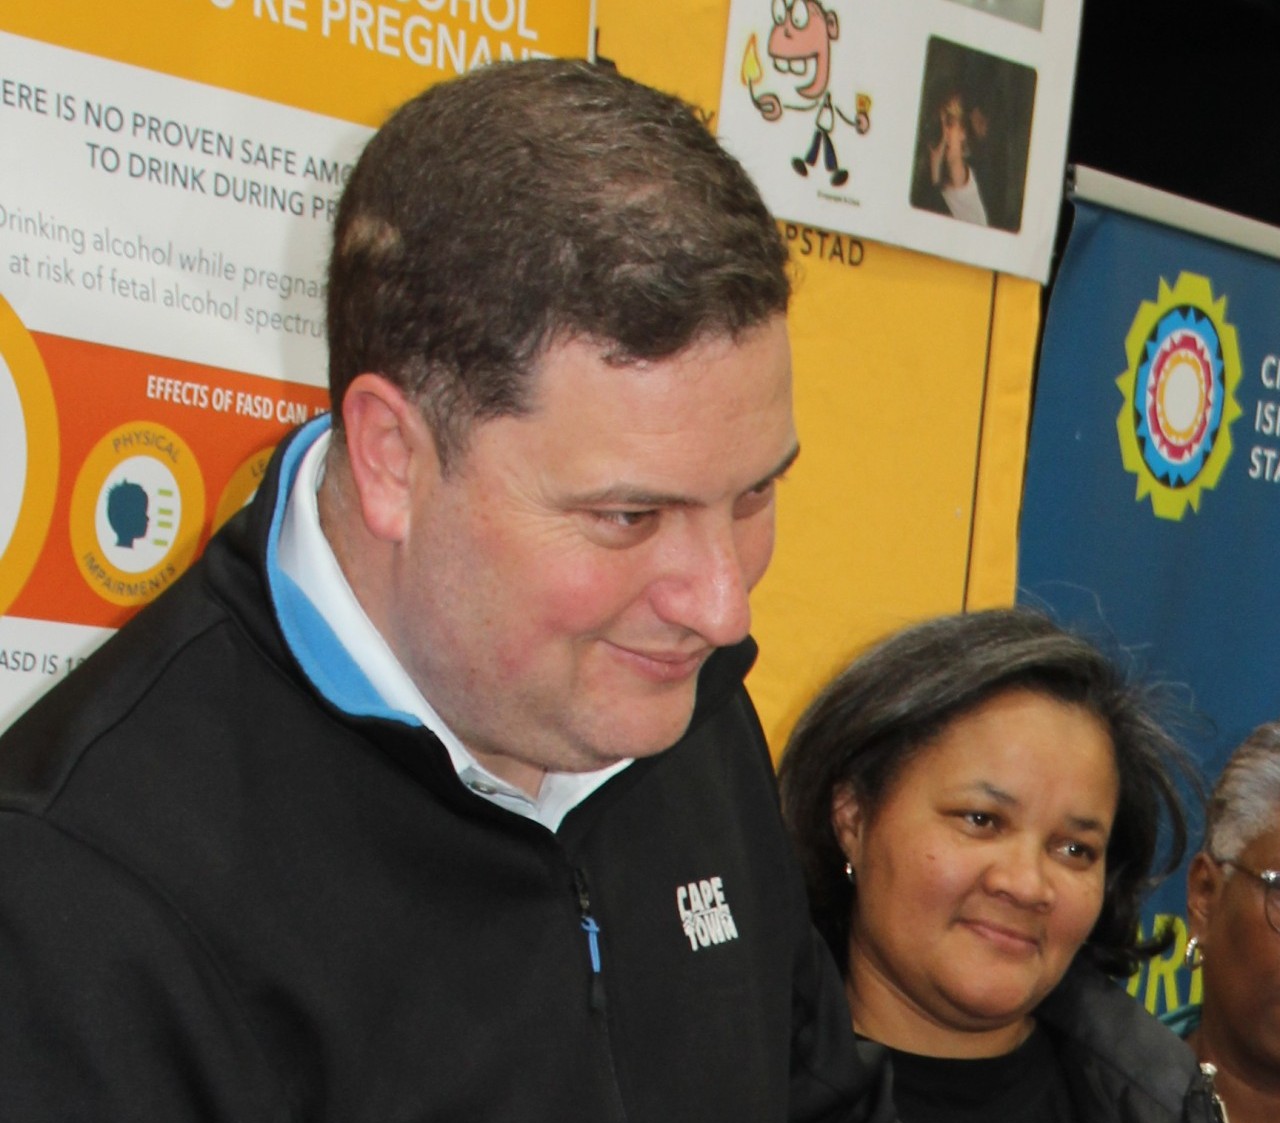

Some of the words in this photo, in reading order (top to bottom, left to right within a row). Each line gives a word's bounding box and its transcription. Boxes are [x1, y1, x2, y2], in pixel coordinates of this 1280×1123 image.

[55, 93, 76, 121] IS
[84, 101, 124, 133] NO
[132, 112, 234, 159] PROVEN
[240, 139, 297, 175] SAFE
[86, 142, 120, 172] TO
[128, 153, 206, 193] DRINK
[213, 172, 304, 215] DURING
[93, 228, 173, 267] alcohol
[178, 247, 236, 281] while
[9, 251, 30, 275] at
[37, 255, 75, 287] risk
[82, 265, 104, 291] of
[109, 275, 157, 304] fetal
[163, 283, 239, 322] alcohol
[147, 375, 208, 409] EFFECTS
[212, 388, 234, 412] OF
[236, 392, 273, 420] FASD
[276, 400, 309, 424] CAN
[112, 430, 180, 463] PHYSICAL
[83, 552, 177, 597] IMPAIRMENTS
[42, 654, 58, 675] IS
[676, 876, 726, 922] CAPE
